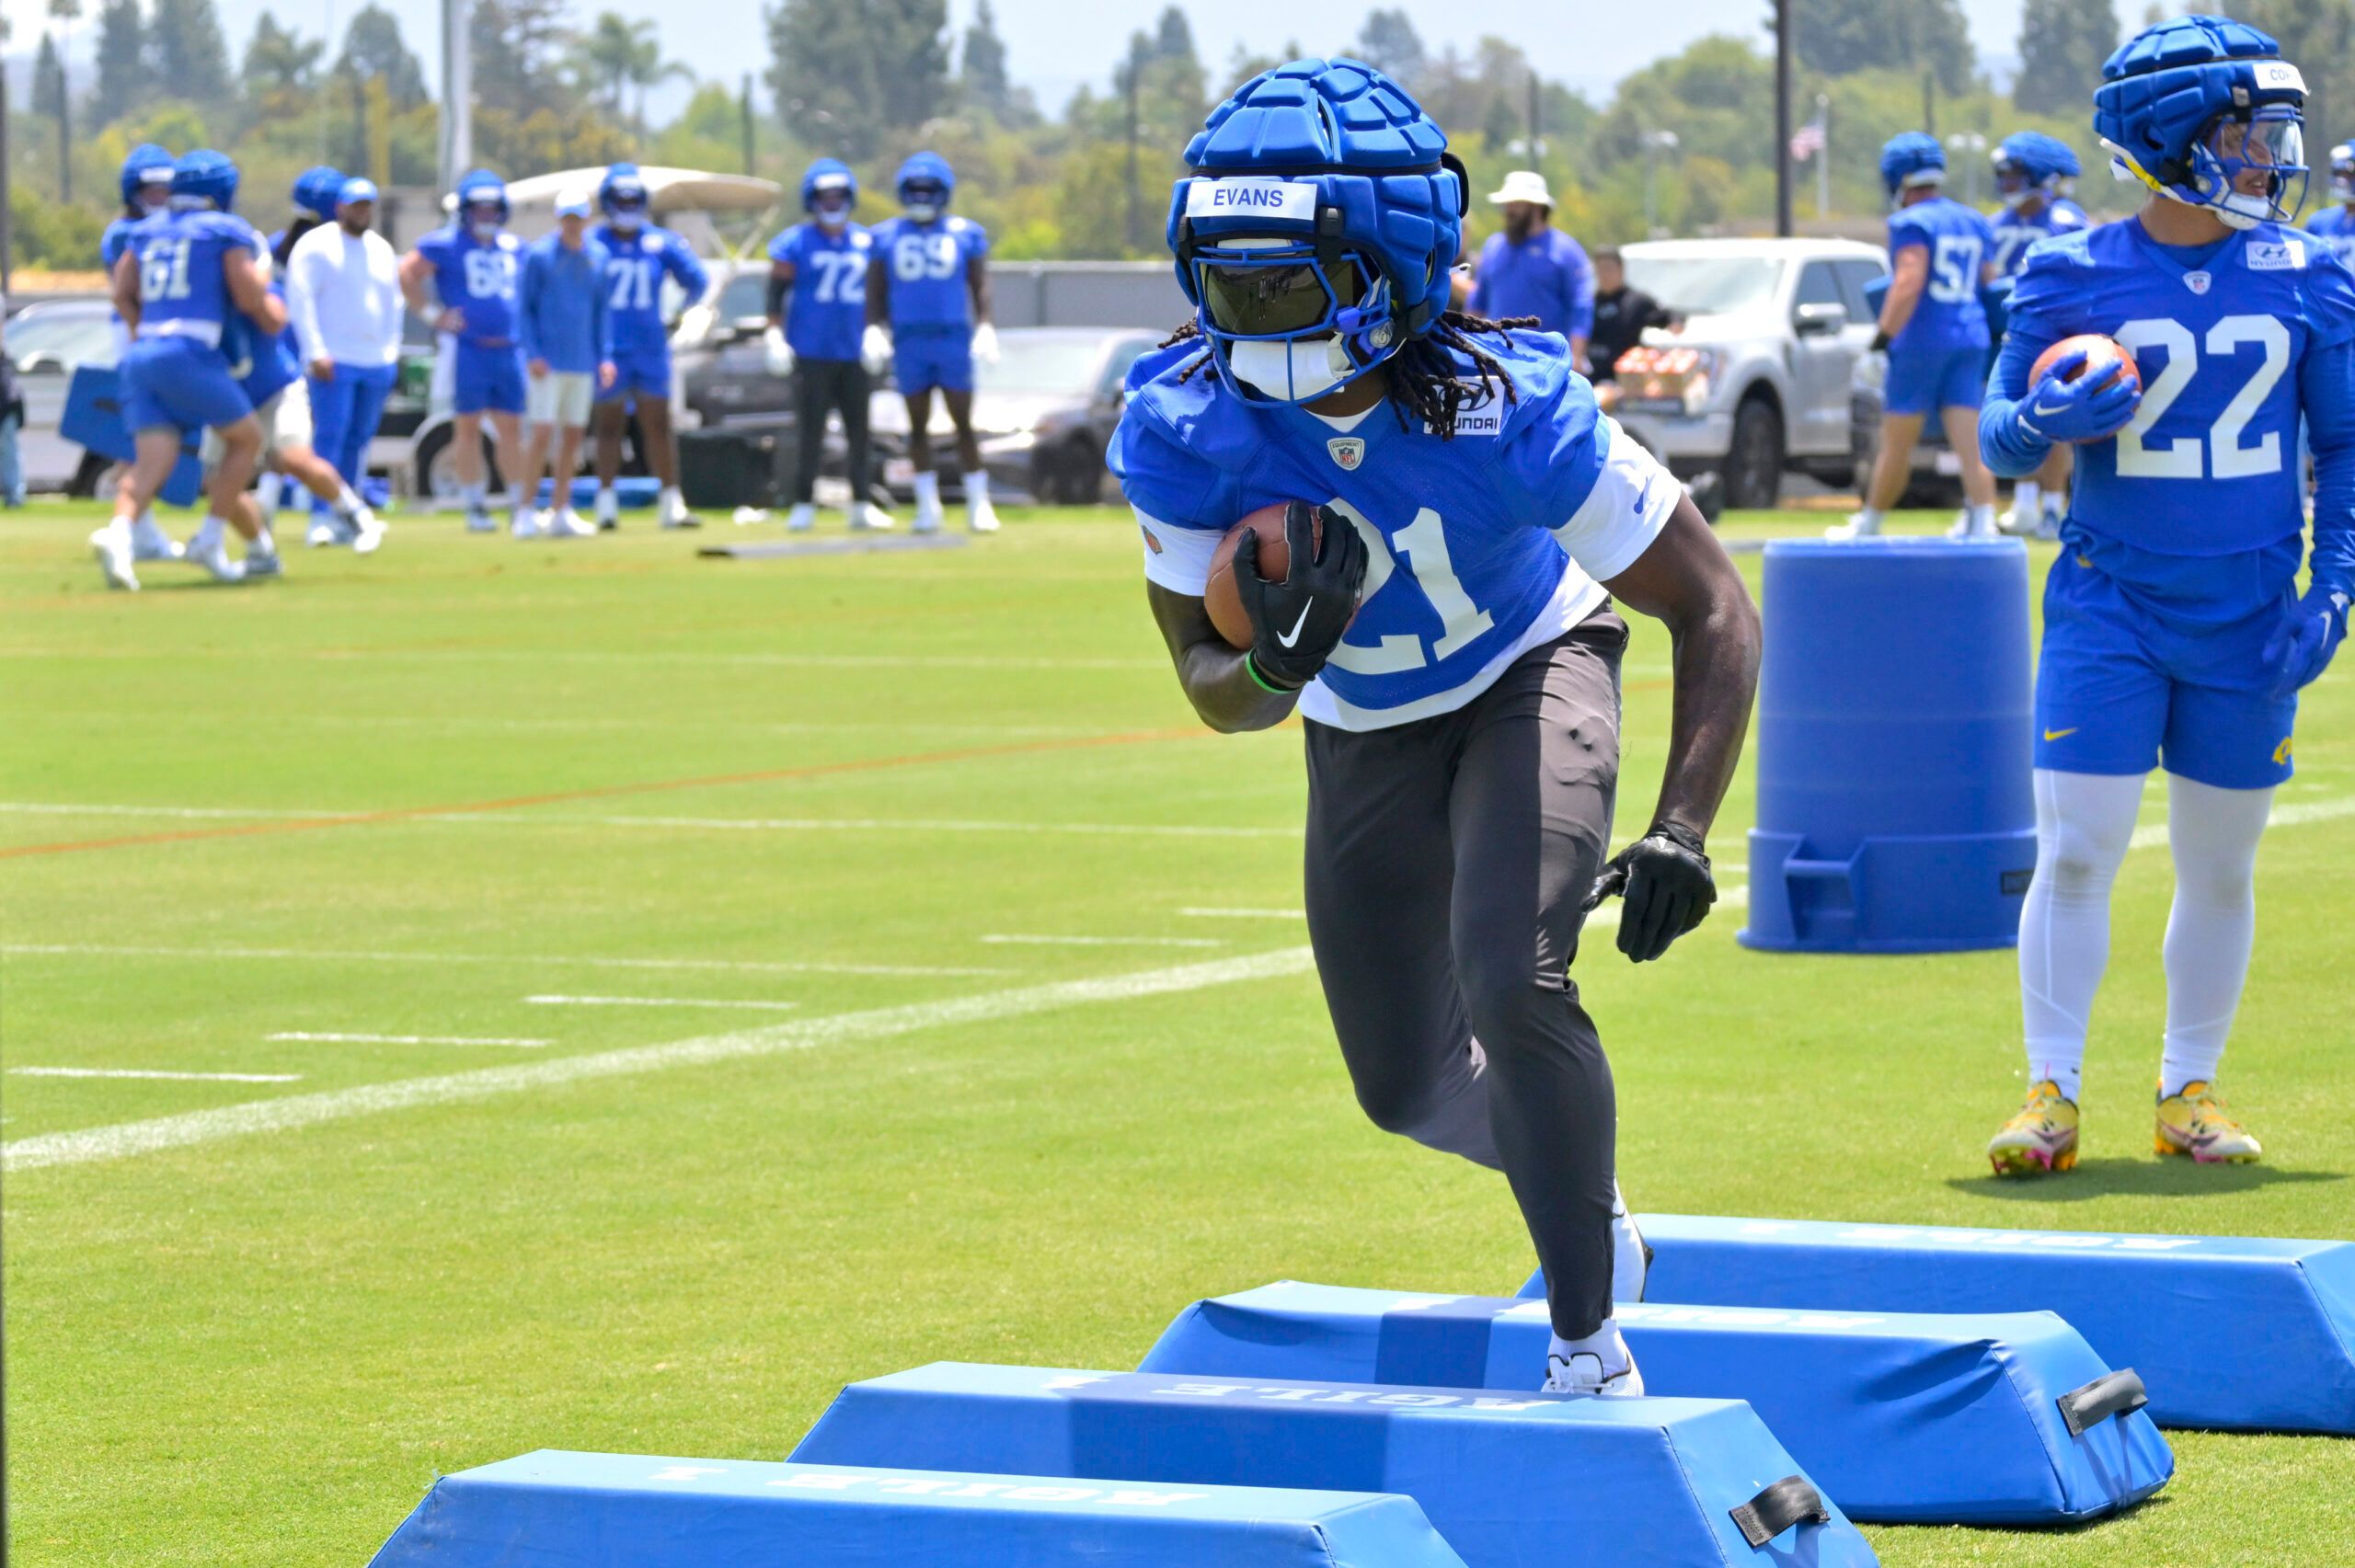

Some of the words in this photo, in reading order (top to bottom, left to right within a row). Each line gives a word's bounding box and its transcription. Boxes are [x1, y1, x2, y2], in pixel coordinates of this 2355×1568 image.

[1213, 189, 1283, 207] EVANS
[142, 237, 191, 303] 61
[810, 250, 867, 304] 72
[894, 234, 957, 281] 69
[1929, 235, 1982, 303] 57
[606, 258, 652, 310] 71
[2114, 314, 2291, 479] 22
[1340, 454, 1354, 464] NFL
[1326, 498, 1495, 675] 21
[1153, 1384, 1561, 1411] AGILE
[764, 1473, 1209, 1505] AGILE
